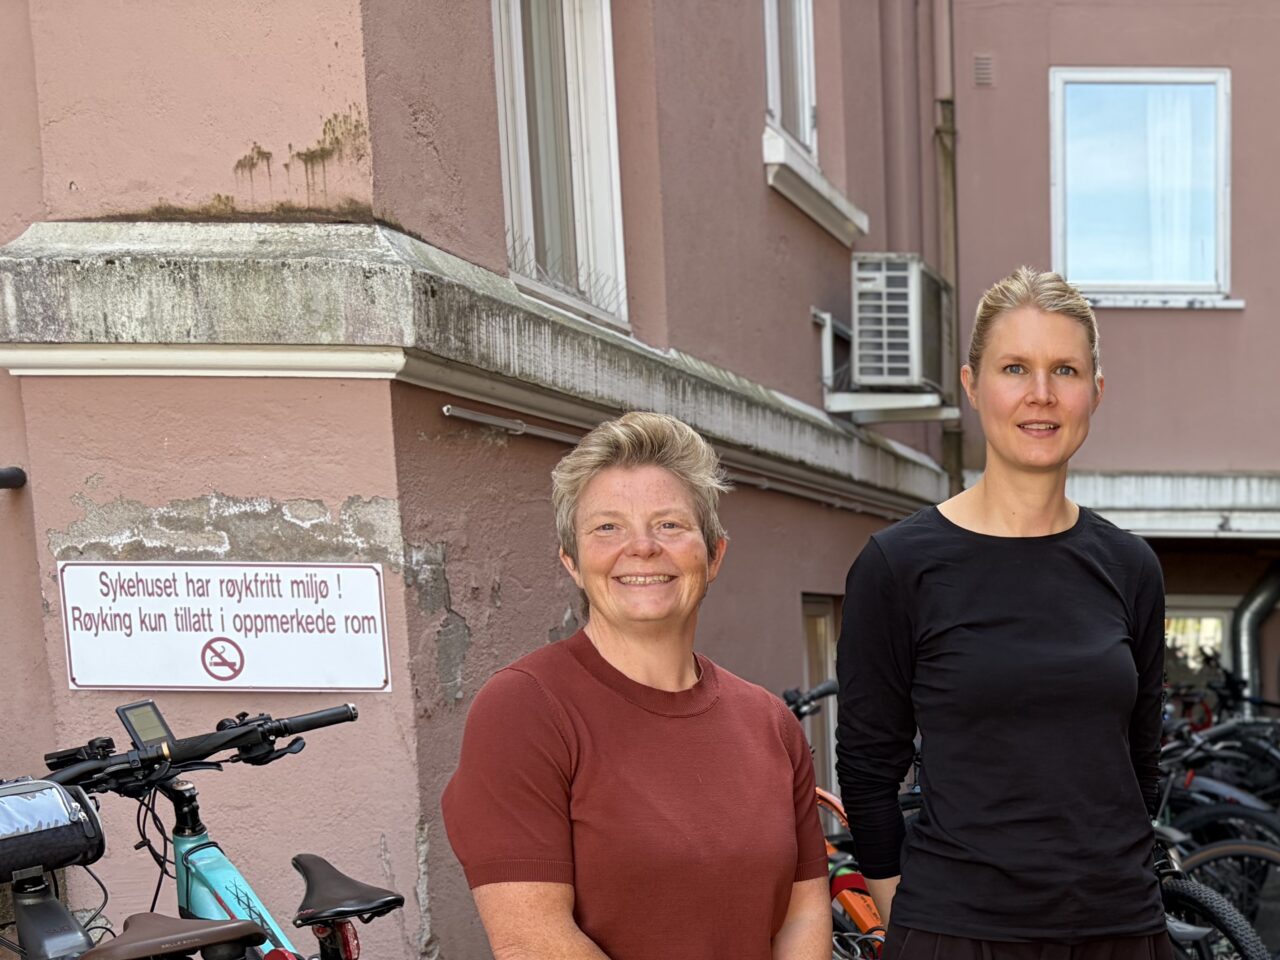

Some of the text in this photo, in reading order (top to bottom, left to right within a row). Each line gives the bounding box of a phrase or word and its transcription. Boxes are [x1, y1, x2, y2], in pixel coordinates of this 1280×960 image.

[98, 571, 342, 605] Sykehuset har røykfritt miljø !
[71, 606, 378, 639] Røyking kun tillatt i oppmerkede rom
